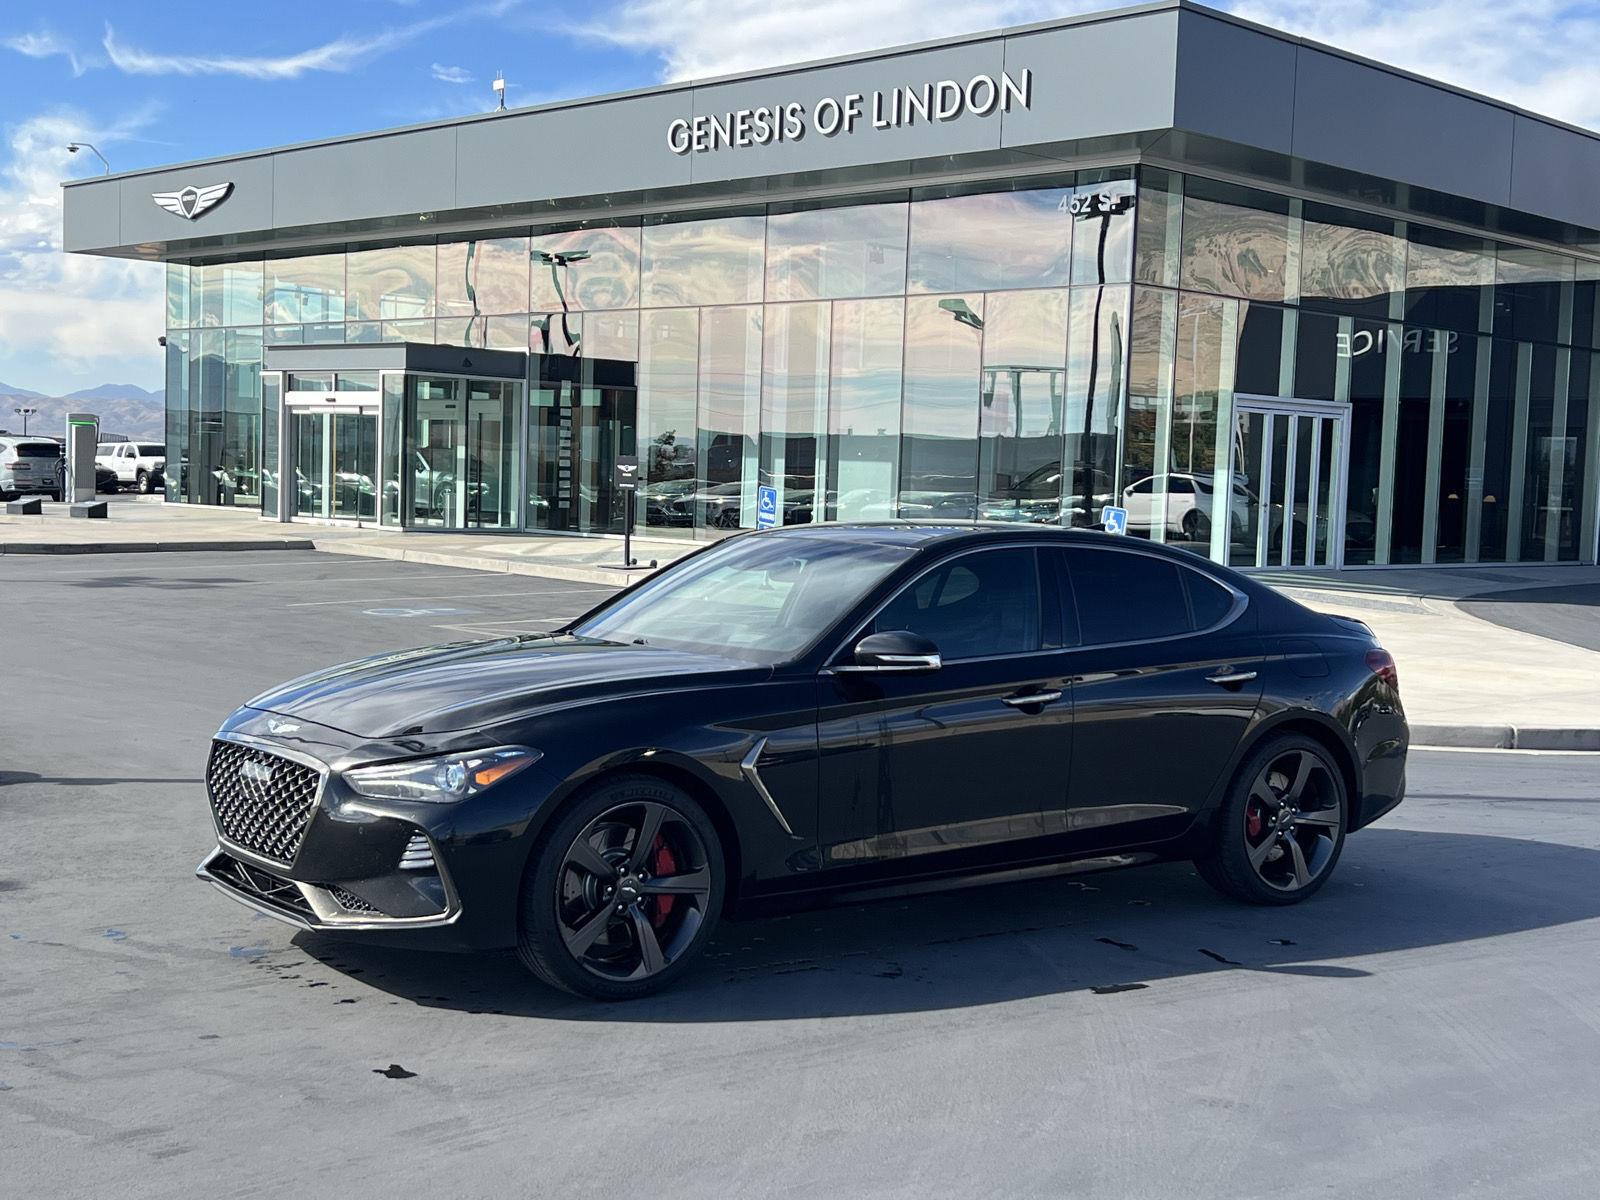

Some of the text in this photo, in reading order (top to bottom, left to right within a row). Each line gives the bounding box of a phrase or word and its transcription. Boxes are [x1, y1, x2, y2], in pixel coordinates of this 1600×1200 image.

[667, 68, 1031, 154] GENESIS OF LINDON
